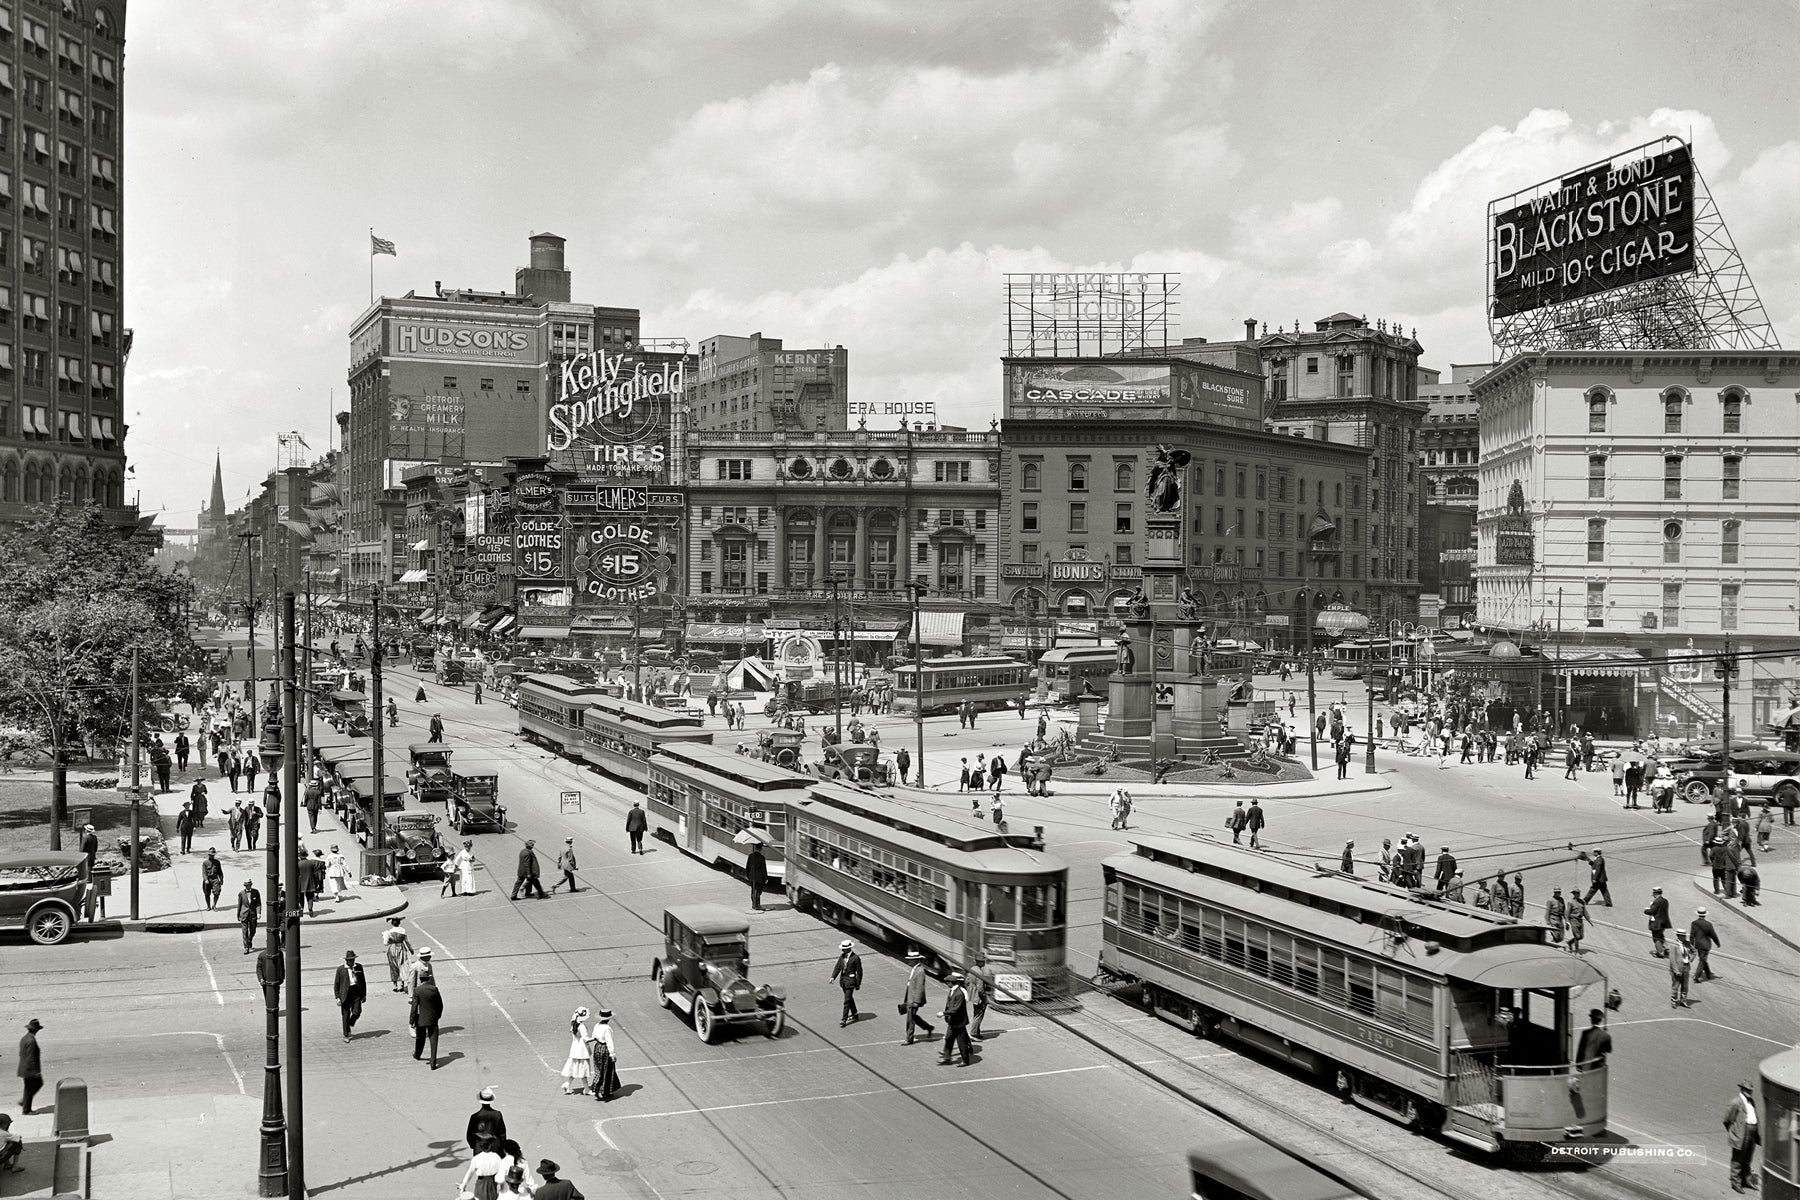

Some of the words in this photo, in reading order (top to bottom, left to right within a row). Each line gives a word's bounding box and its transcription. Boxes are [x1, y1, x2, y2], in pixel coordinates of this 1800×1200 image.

[1529, 181, 1582, 217] WAITT
[1586, 176, 1598, 197] &
[1606, 156, 1656, 192] BOND
[1496, 174, 1683, 280] BLACKSTONE
[1521, 267, 1555, 289] MILD
[1600, 230, 1689, 275] CIGAR
[1031, 272, 1149, 294] HENKEL'S
[1053, 300, 1136, 321] FLOUR
[1584, 304, 1612, 319] CADY
[398, 325, 529, 352] HUDSON'S
[1027, 330, 1080, 340] ALWAYS
[424, 346, 458, 354] GROWS
[774, 353, 834, 364] KERN'S
[1026, 389, 1136, 400] CASCADE
[1202, 381, 1245, 397] BLACKSTONE
[425, 395, 460, 404] DETROIT
[547, 361, 684, 451] Springfield
[1226, 394, 1244, 404] SURE
[420, 404, 465, 413] CREAMERY
[884, 402, 934, 414] HOUSE
[426, 413, 458, 424] MILK
[589, 444, 665, 462] TIRES
[586, 464, 605, 472] MADE
[609, 464, 618, 472] TO
[621, 464, 641, 472] MAKE
[643, 464, 663, 472] GOOD
[515, 486, 553, 496] ELMER'S
[567, 494, 595, 502] SUITS
[598, 487, 646, 511] ELMER'S
[652, 495, 679, 503] FURS
[521, 521, 555, 531] GOLDE
[478, 536, 512, 547] GOLDE
[516, 534, 562, 549] CLOTHES
[590, 523, 653, 545] GOLDE
[478, 553, 512, 562] CLOTHES
[525, 552, 552, 572] $15
[602, 555, 640, 575] $15
[1053, 565, 1102, 580] BOND'S
[588, 580, 657, 601] CLOTHES
[285, 910, 300, 918] FORT
[1357, 1026, 1394, 1049] 7126
